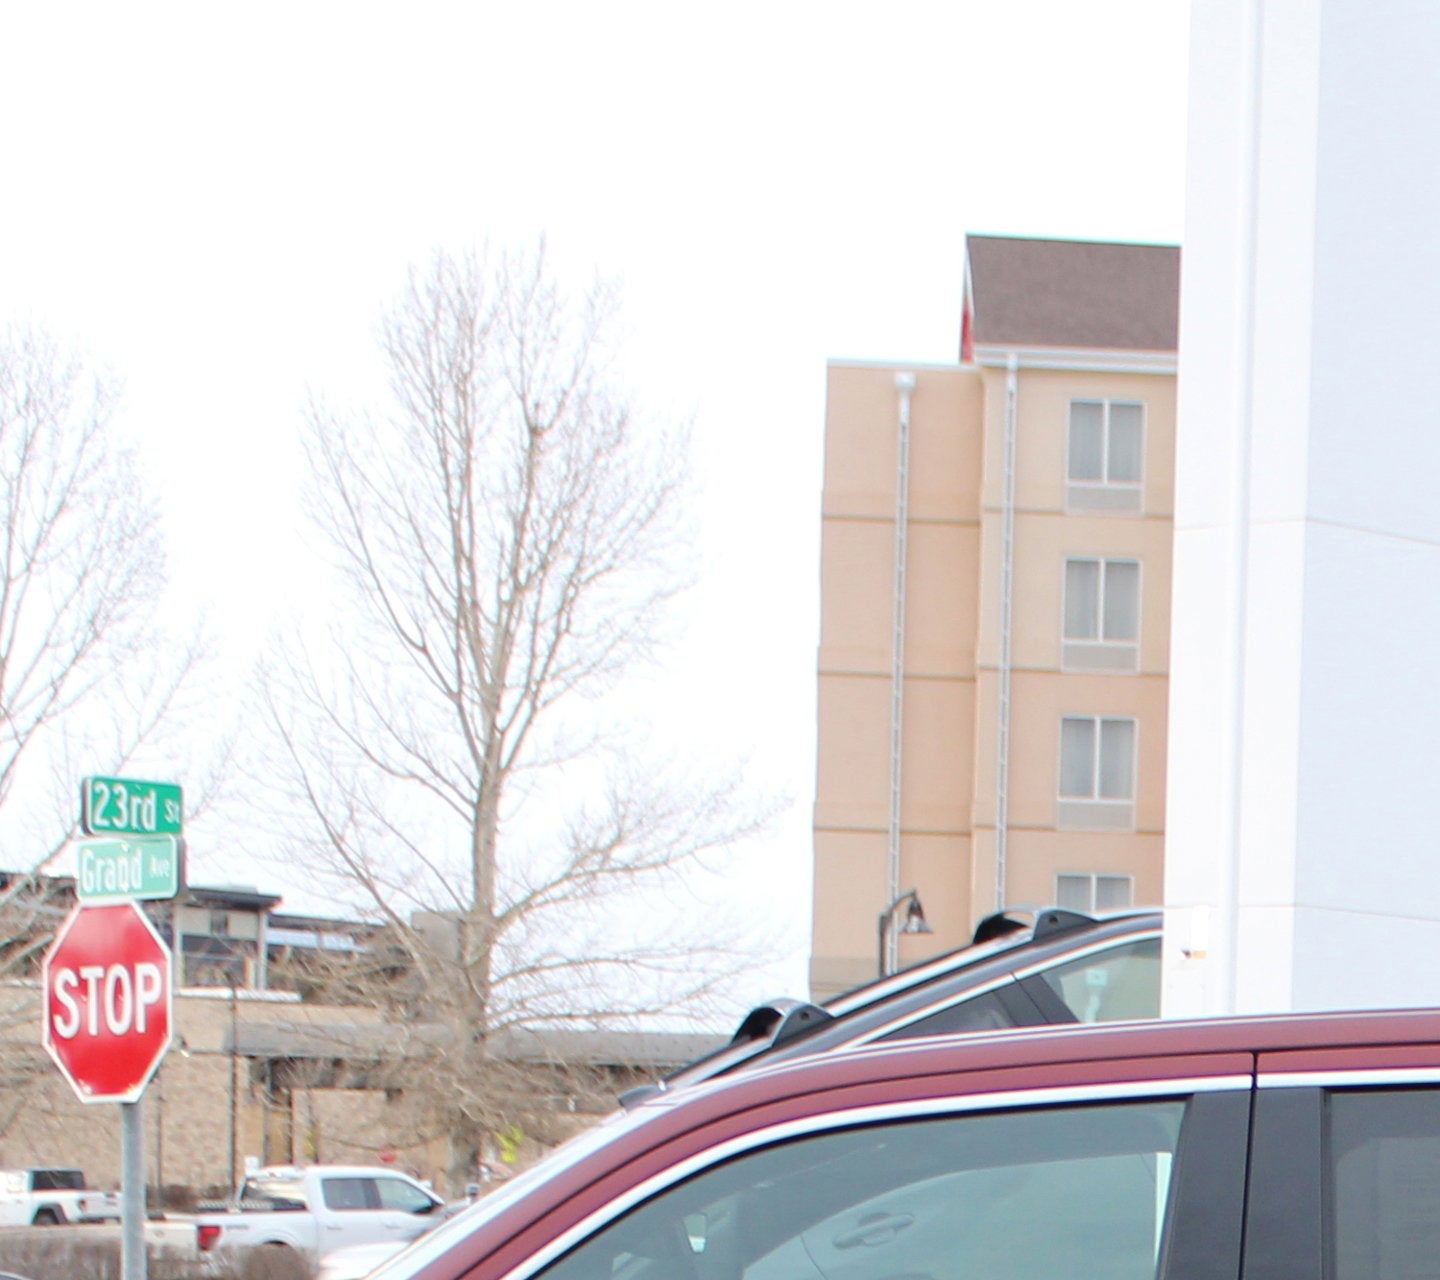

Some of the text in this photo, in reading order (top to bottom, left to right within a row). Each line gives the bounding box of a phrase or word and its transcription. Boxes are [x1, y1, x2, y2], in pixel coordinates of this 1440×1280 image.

[93, 781, 157, 832] 23rd
[80, 848, 143, 893] Grand
[53, 962, 162, 1039] STOP
